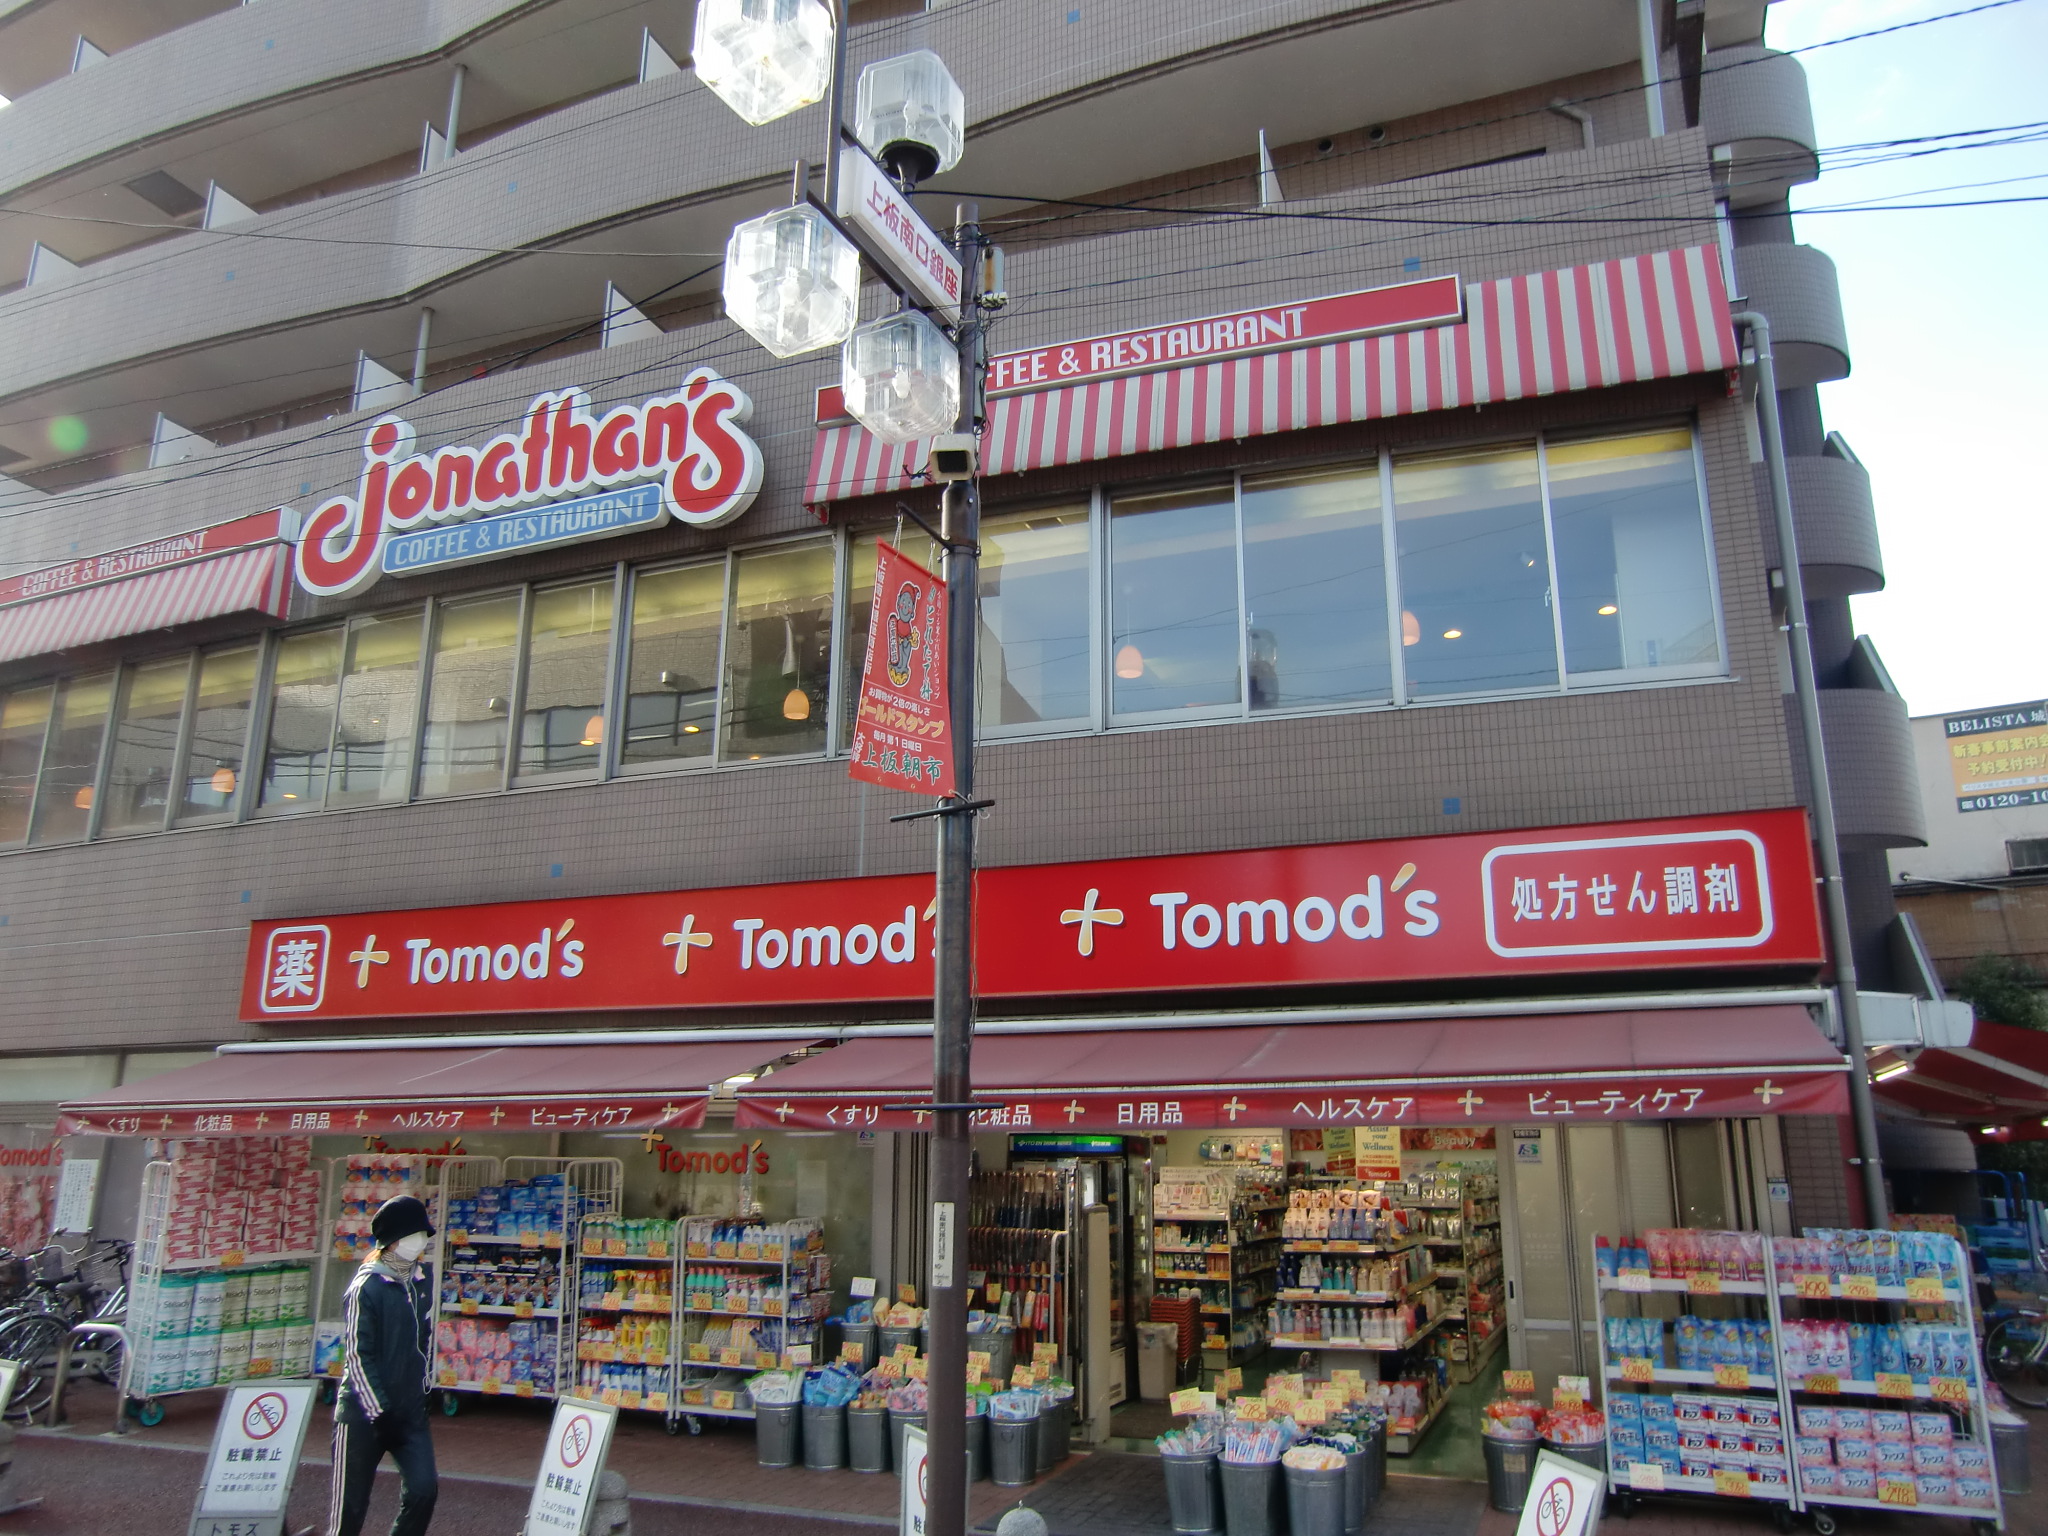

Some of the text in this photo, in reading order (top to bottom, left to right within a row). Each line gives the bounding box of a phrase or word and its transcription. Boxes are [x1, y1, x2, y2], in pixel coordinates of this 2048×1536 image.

[866, 180, 958, 302] 上板南口銀座
[987, 306, 1307, 388] FEE & RESTAURANT
[394, 491, 649, 566] COFFEE & RESTAURANT
[22, 531, 208, 597] COFFEE & RESTAURANT
[1948, 712, 2027, 734] BELISTA
[862, 741, 944, 786] 上板朝市
[1150, 862, 1440, 949] Tomod's
[1511, 863, 1740, 923] 処方せん調剤
[406, 918, 584, 985] Tomod's
[733, 896, 936, 970] Tomod'
[271, 939, 319, 998] 薬
[107, 1107, 633, 1133] くすり 化粧品 日用品 ヘルスケア ビューティケア
[825, 1088, 1704, 1126] くすり 化粧品 日用品 ヘルスケア ビューティケア
[656, 1139, 769, 1174] Tomod's
[1362, 1142, 1394, 1151] Wellness
[1434, 1135, 1476, 1147] Beauty
[226, 1447, 283, 1462] 駐輪禁止
[545, 1472, 582, 1496] 駐輪禁止
